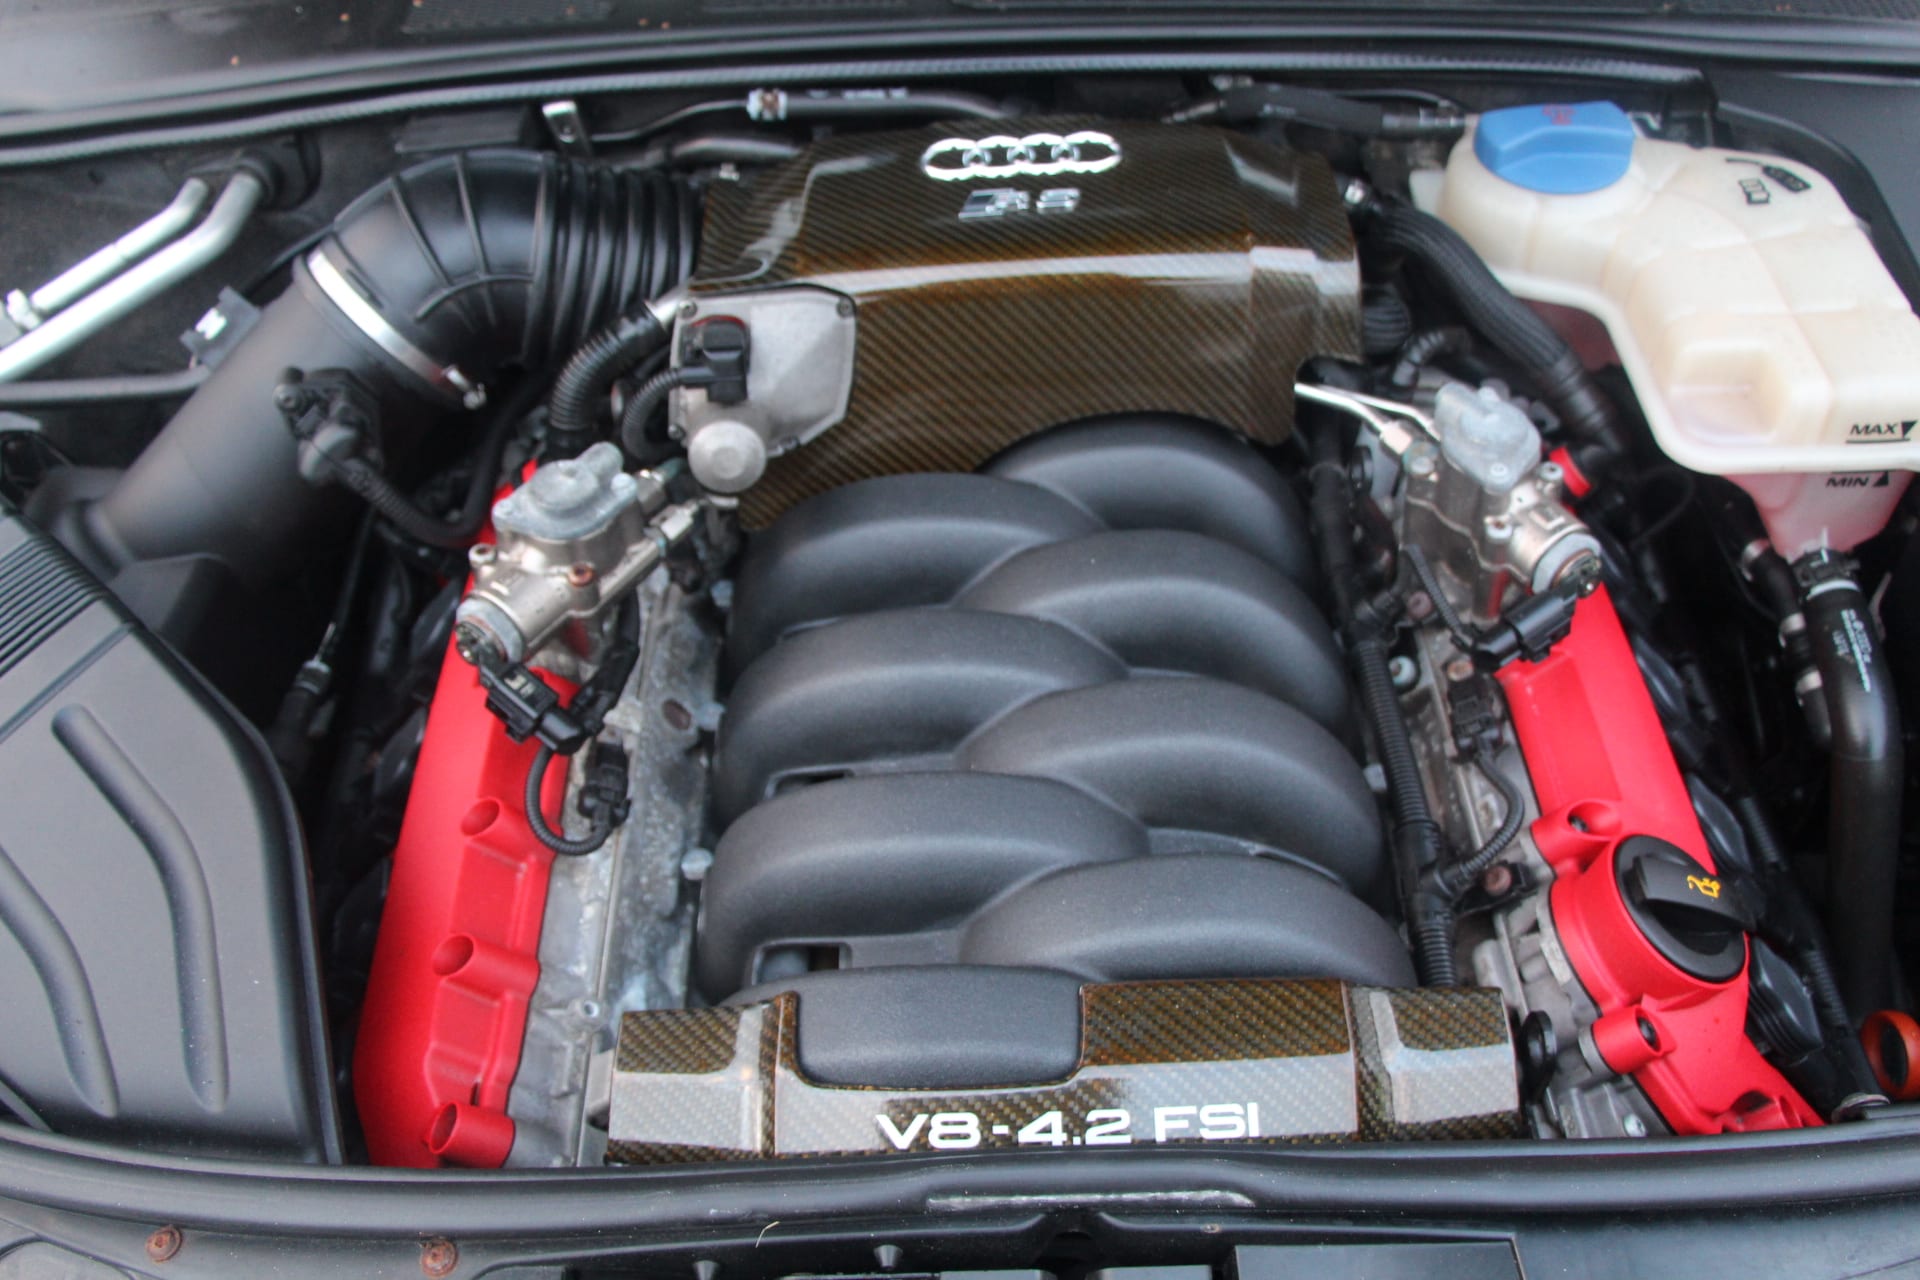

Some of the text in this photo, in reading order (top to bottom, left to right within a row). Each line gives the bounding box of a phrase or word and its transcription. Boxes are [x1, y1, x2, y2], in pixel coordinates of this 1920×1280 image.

[1850, 423, 1898, 435] MAX
[1825, 476, 1870, 488] MIN
[1154, 1102, 1260, 1143] FSI
